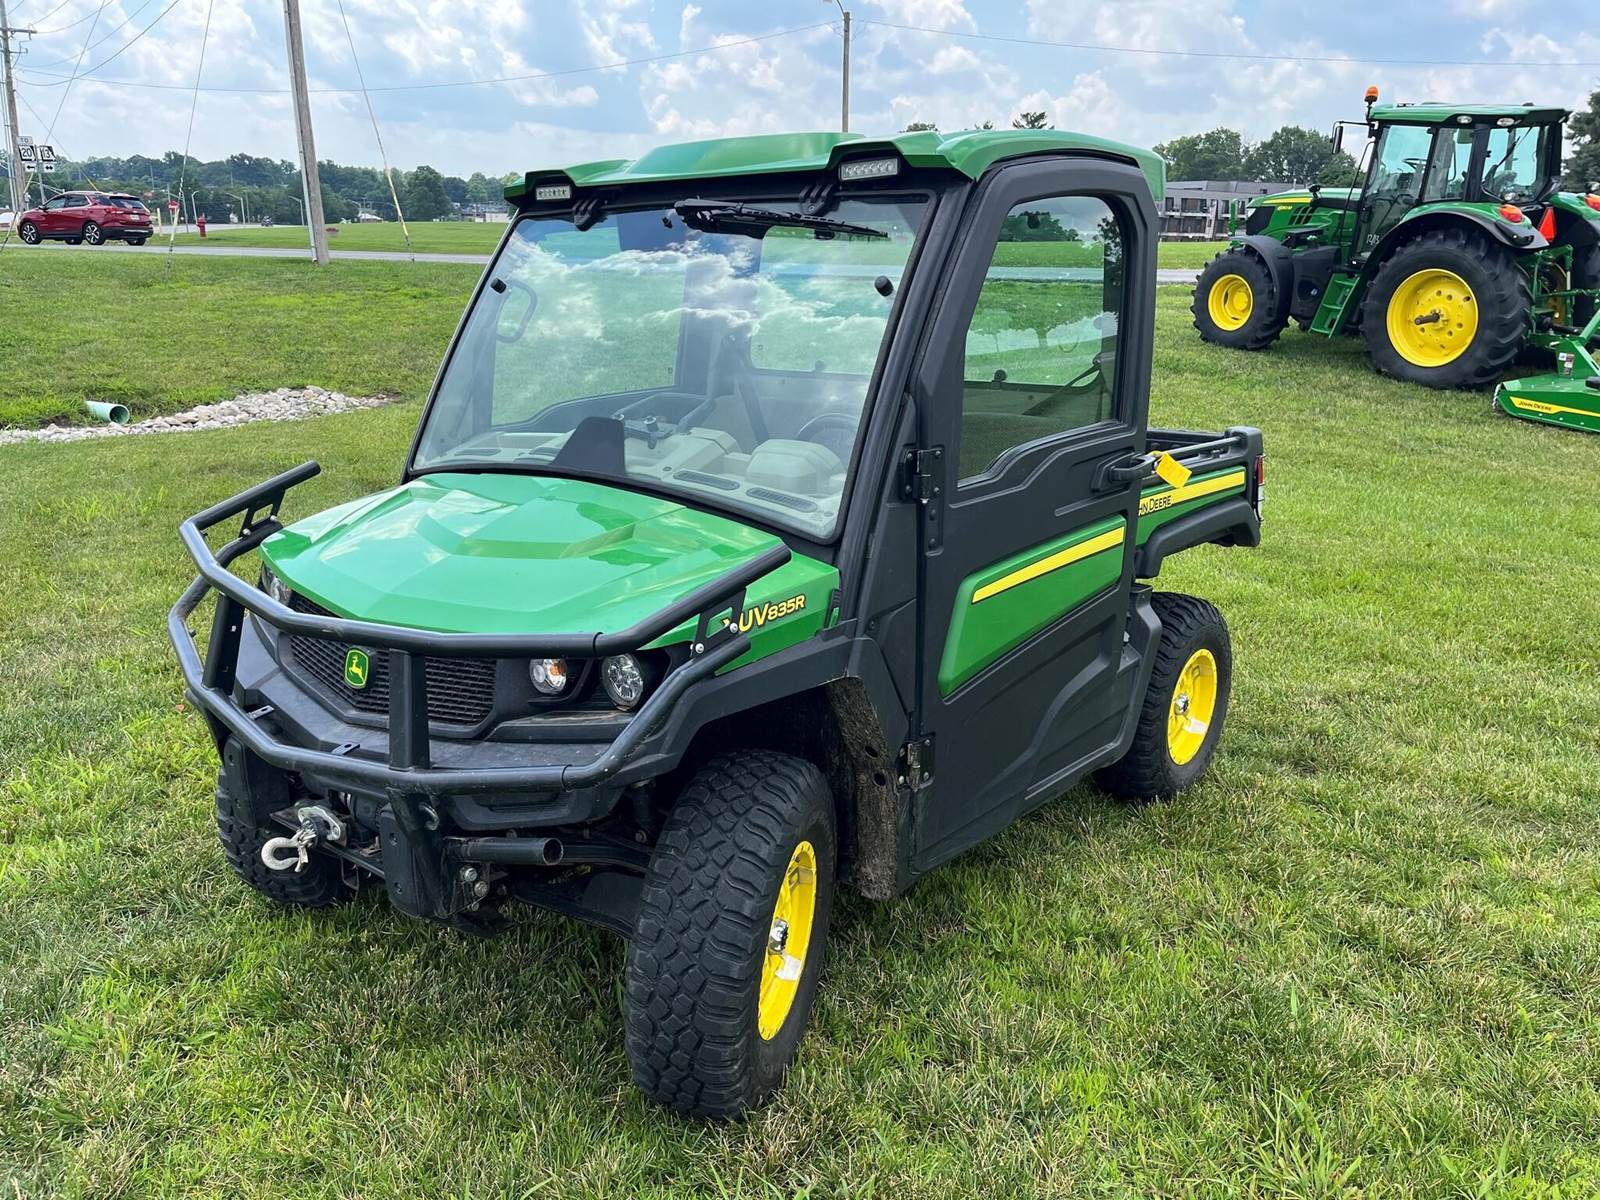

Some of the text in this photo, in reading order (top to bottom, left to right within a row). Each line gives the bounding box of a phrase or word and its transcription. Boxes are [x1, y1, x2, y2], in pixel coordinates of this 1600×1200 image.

[21, 147, 32, 158] 20
[41, 148, 51, 159] 13
[1149, 495, 1172, 511] DEERE
[722, 594, 806, 632] UV835R
